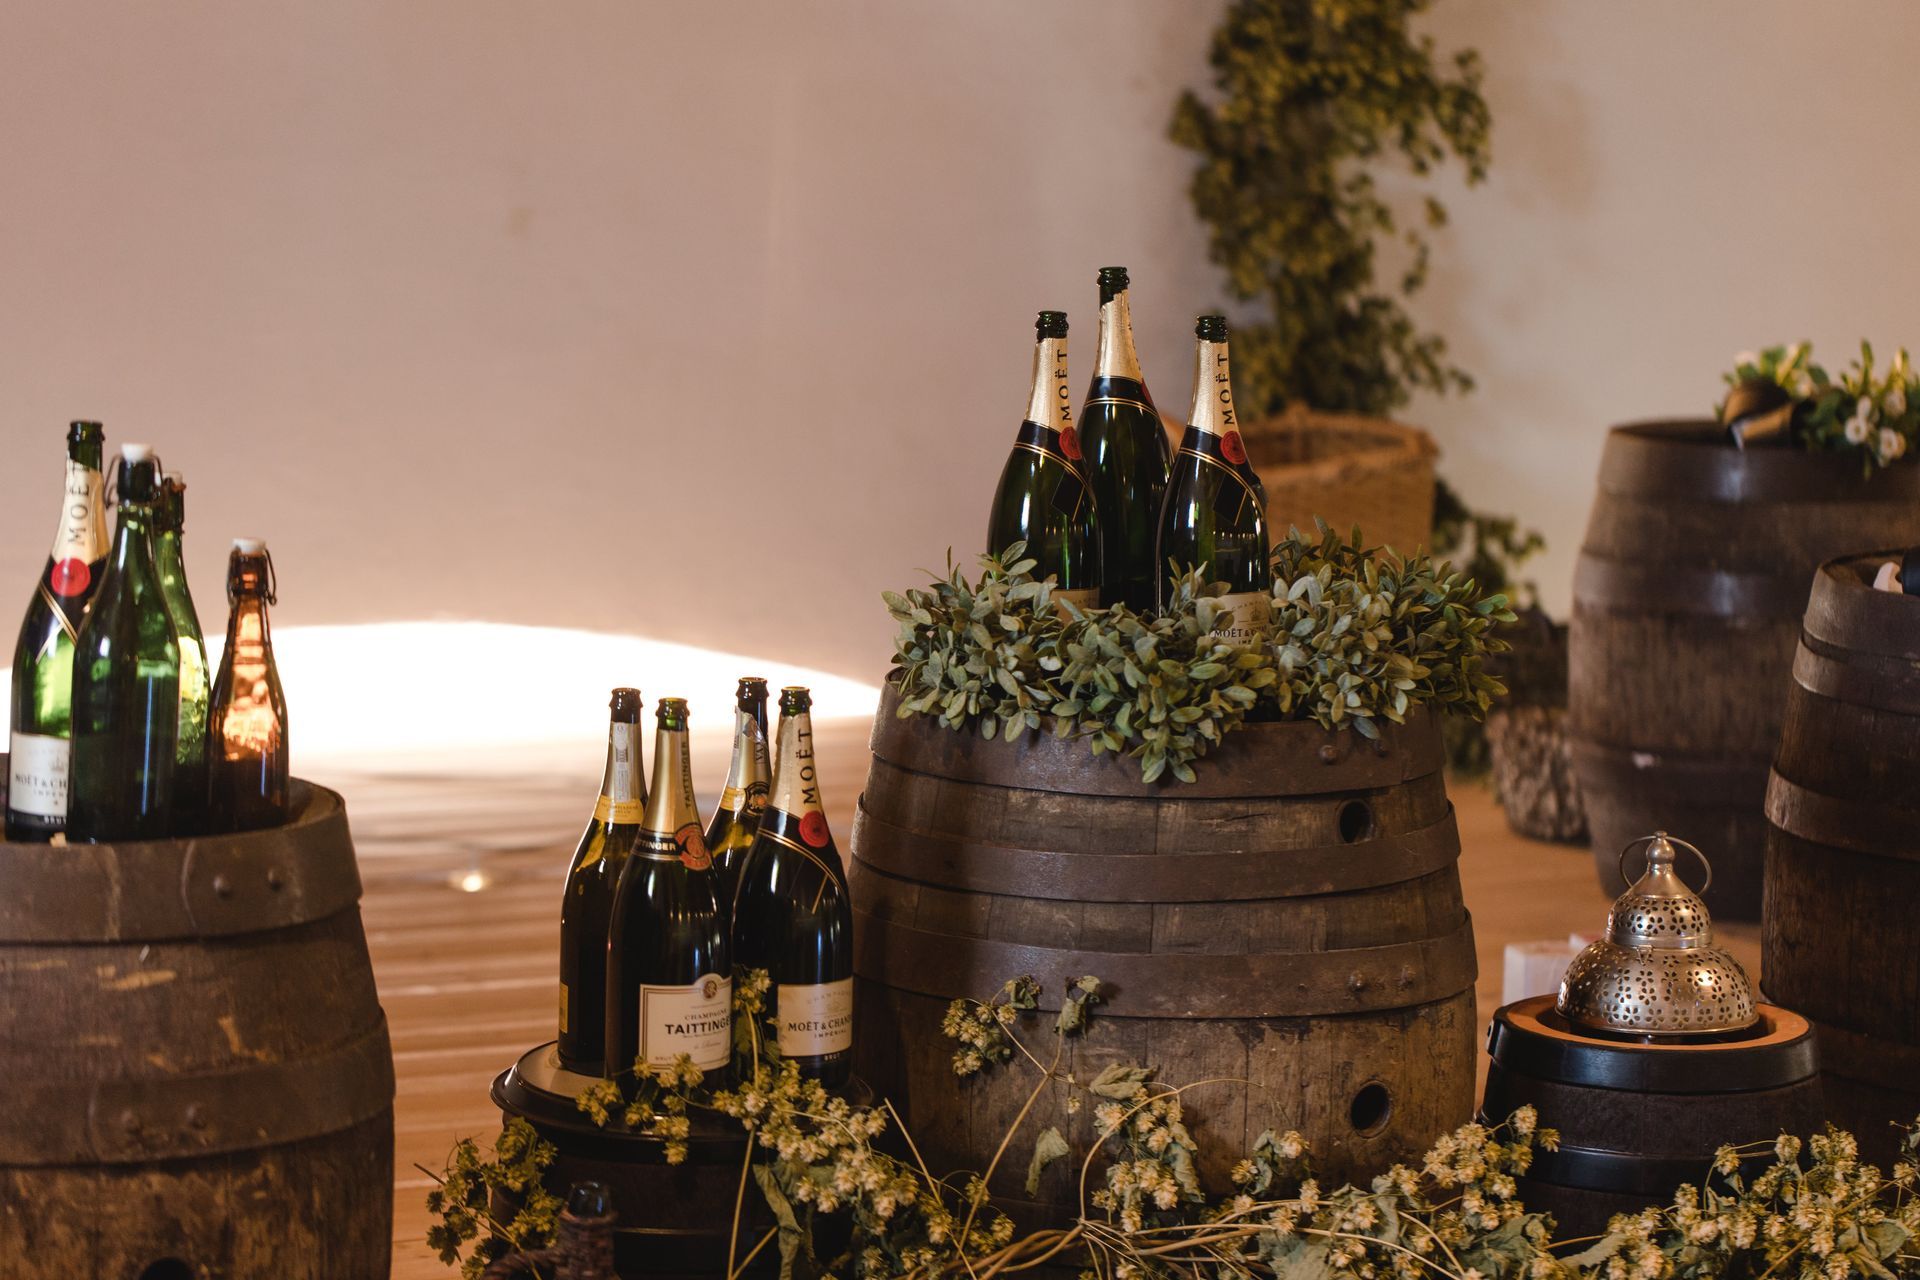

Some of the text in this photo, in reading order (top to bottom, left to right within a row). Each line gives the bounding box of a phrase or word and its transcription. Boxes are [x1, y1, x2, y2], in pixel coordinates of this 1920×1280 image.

[1054, 348, 1072, 422] MOËT
[1215, 353, 1235, 425] MOËT
[1214, 627, 1243, 638] MOËT
[681, 741, 692, 809] TAITTINGER
[795, 728, 817, 805] MOËT
[664, 1015, 731, 1035] TAITTINGE
[788, 1021, 820, 1032] MOËT
